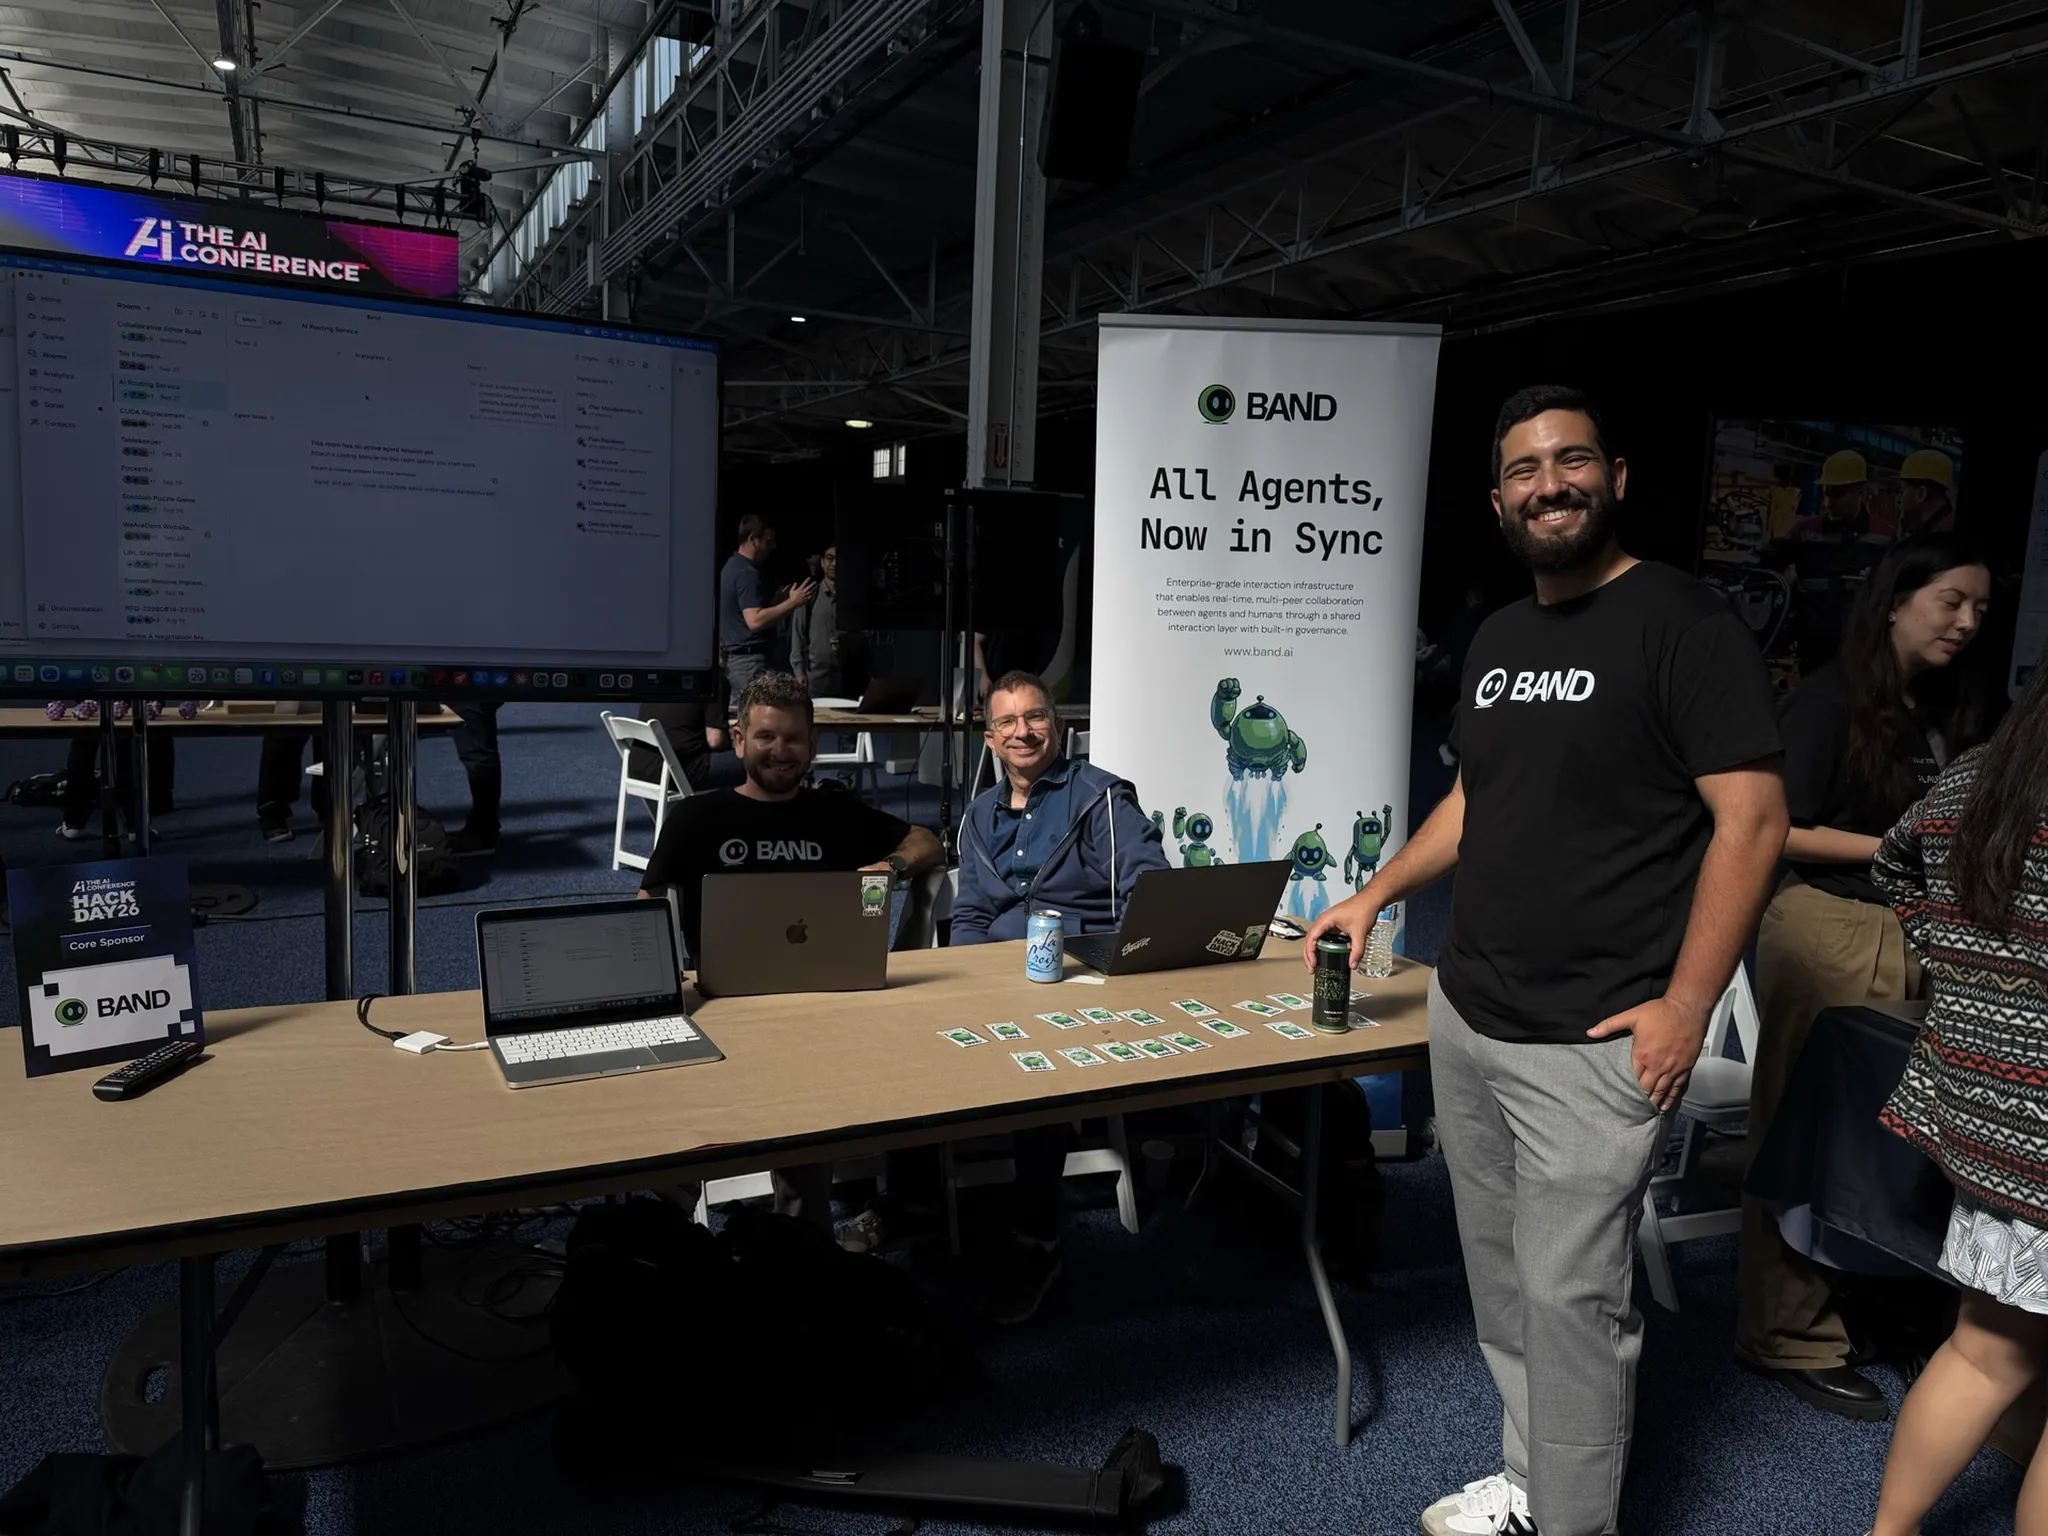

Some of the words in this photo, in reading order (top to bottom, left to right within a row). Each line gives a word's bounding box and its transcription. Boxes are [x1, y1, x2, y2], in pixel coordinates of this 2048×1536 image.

[181, 222, 234, 247] THE
[240, 231, 267, 251] AI
[180, 244, 360, 282] CONFERENCE
[117, 302, 141, 311] Rooms
[43, 371, 75, 380] Analytics
[127, 380, 154, 390] Routing
[155, 381, 181, 391] Service
[1247, 391, 1337, 422] BAND
[44, 420, 76, 429] Contacts
[1150, 467, 1216, 501] All
[1238, 470, 1383, 511] Agents,
[1141, 517, 1208, 551] Now
[1229, 518, 1271, 553] in
[1295, 521, 1383, 562] Sync
[1166, 578, 1241, 589] Enterprise-grade
[1243, 580, 1292, 590] interaction
[1293, 580, 1354, 591] infrastructure
[1155, 593, 1173, 602] that
[1176, 593, 1210, 603] enables
[1212, 594, 1254, 604] real-time,
[1256, 595, 1303, 606] multi-peer
[1305, 596, 1364, 606] collaboration
[1157, 608, 1196, 617] between
[1197, 610, 1227, 619] agents
[1229, 609, 1246, 618] and
[1248, 609, 1283, 619] humans
[1285, 610, 1320, 621] through
[1322, 612, 1328, 620] a
[1330, 611, 1361, 621] shared
[1168, 623, 1215, 633] interaction
[1217, 624, 1238, 634] layer
[1240, 624, 1259, 634] with
[1261, 625, 1294, 634] built-in
[1295, 626, 1349, 636] governance.
[1224, 647, 1294, 657] www.band.ai
[1509, 668, 1595, 703] BAND
[756, 840, 823, 861] BAND
[86, 881, 136, 891] CONFERENCE
[72, 889, 137, 909] HACK
[74, 903, 140, 923] DAY26
[69, 939, 97, 951] Core
[100, 933, 145, 949] Sponsor
[1039, 930, 1056, 953] La
[97, 989, 170, 1017] BAND
